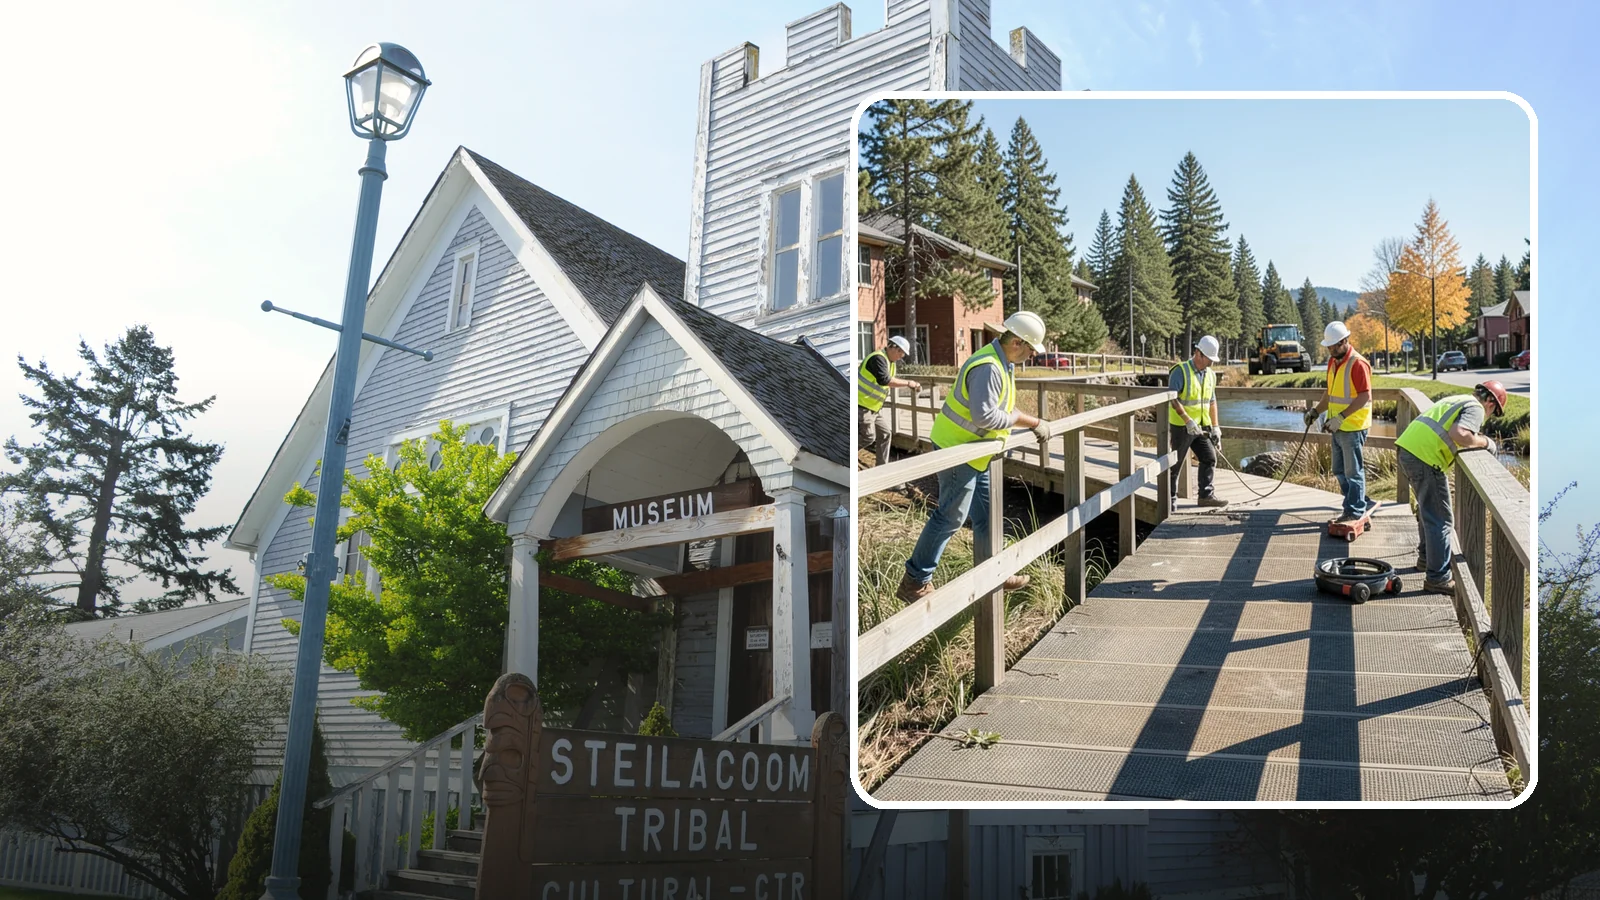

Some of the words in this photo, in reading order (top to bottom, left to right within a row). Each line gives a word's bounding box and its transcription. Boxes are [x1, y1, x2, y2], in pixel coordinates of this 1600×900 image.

[613, 491, 713, 530] MUSEUM
[550, 738, 809, 792] STEILACOOM
[614, 806, 758, 852] TRIBAL
